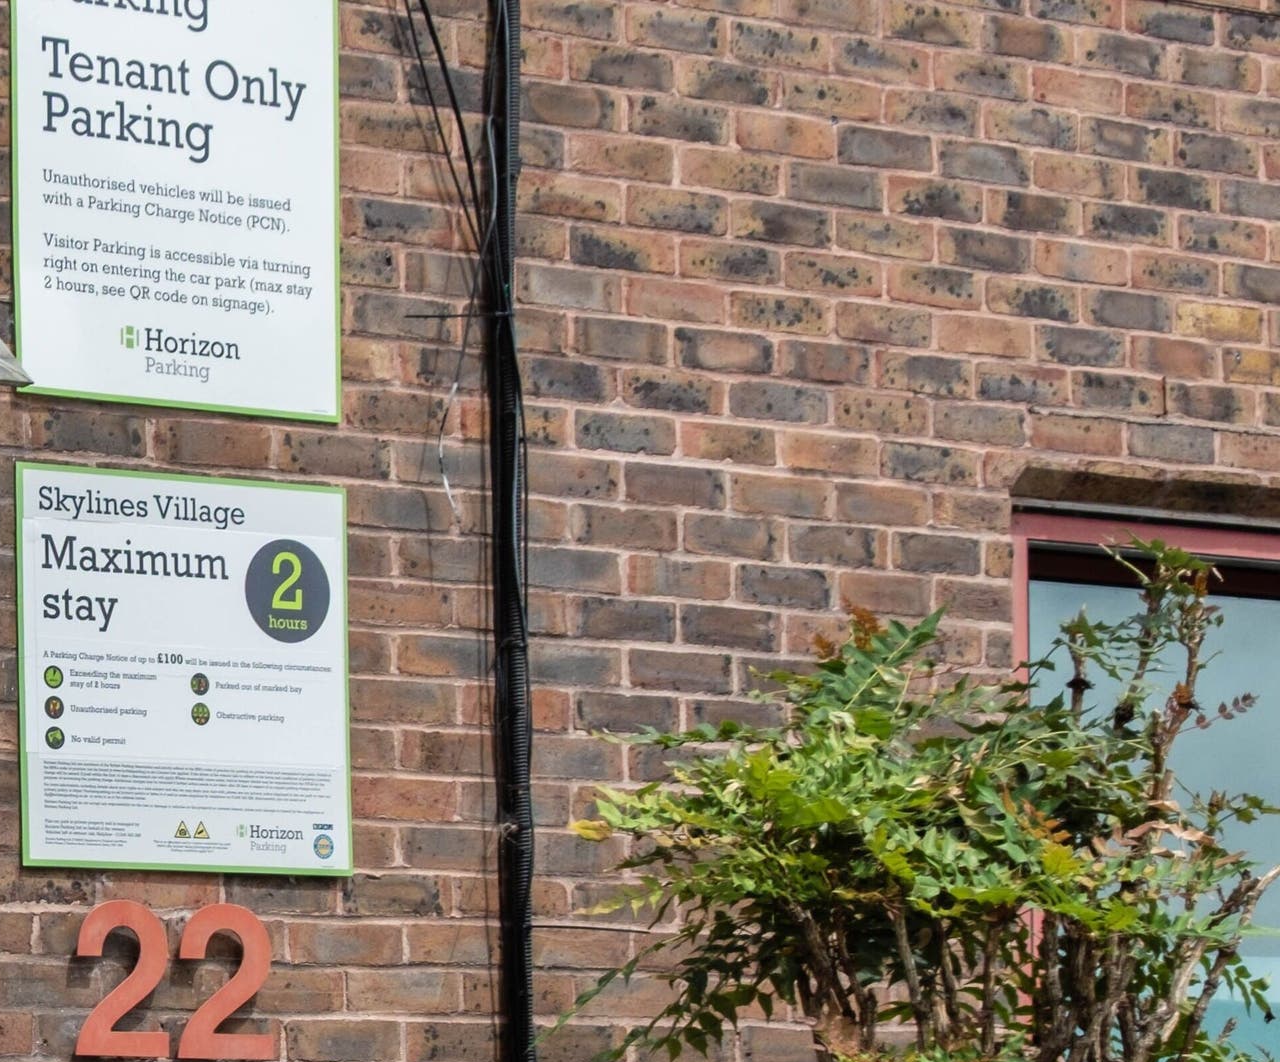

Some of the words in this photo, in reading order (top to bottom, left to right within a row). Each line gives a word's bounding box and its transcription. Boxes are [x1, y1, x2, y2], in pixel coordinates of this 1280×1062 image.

[41, 36, 190, 97] Tenant
[205, 59, 306, 122] Only
[42, 91, 213, 163] Parking
[42, 168, 136, 194] Unauthorised
[139, 182, 195, 201] vehicles
[199, 188, 223, 204] will
[227, 192, 244, 207] be
[248, 194, 291, 212] issued
[42, 191, 71, 208] with
[76, 198, 84, 209] a
[88, 196, 141, 218] Parking
[144, 202, 195, 224] Charge
[199, 208, 242, 227] Notice
[246, 213, 290, 235] (PCN).
[43, 232, 89, 251] Visitor
[93, 237, 146, 261] Parking
[150, 244, 160, 259] is
[164, 247, 235, 268] accessible
[239, 255, 258, 270] via
[262, 259, 311, 279] turning
[43, 257, 77, 276] right
[81, 263, 98, 275] on
[102, 262, 161, 284] entering
[164, 268, 186, 283] the
[189, 274, 211, 286] car
[215, 273, 246, 292] park
[250, 277, 282, 295] (max
[286, 282, 313, 300] stay
[44, 277, 52, 289] 2
[56, 277, 99, 297] hours,
[102, 285, 126, 298] see
[129, 285, 151, 302] QR
[154, 287, 188, 303] code
[191, 294, 209, 306] on
[211, 294, 275, 315] signage).
[144, 328, 240, 360] Horizon
[144, 357, 210, 383] Parking
[39, 485, 149, 522] Skylines
[153, 495, 245, 530] Village
[41, 534, 229, 581] Maximum
[271, 551, 303, 611] 2
[42, 588, 118, 633] stay
[268, 615, 308, 631] hours
[51, 651, 77, 662] Parking
[79, 652, 105, 663] Charge
[157, 653, 183, 665] £100
[250, 824, 304, 841] Horizon
[250, 841, 287, 854] Parking
[76, 900, 274, 1059] 22
